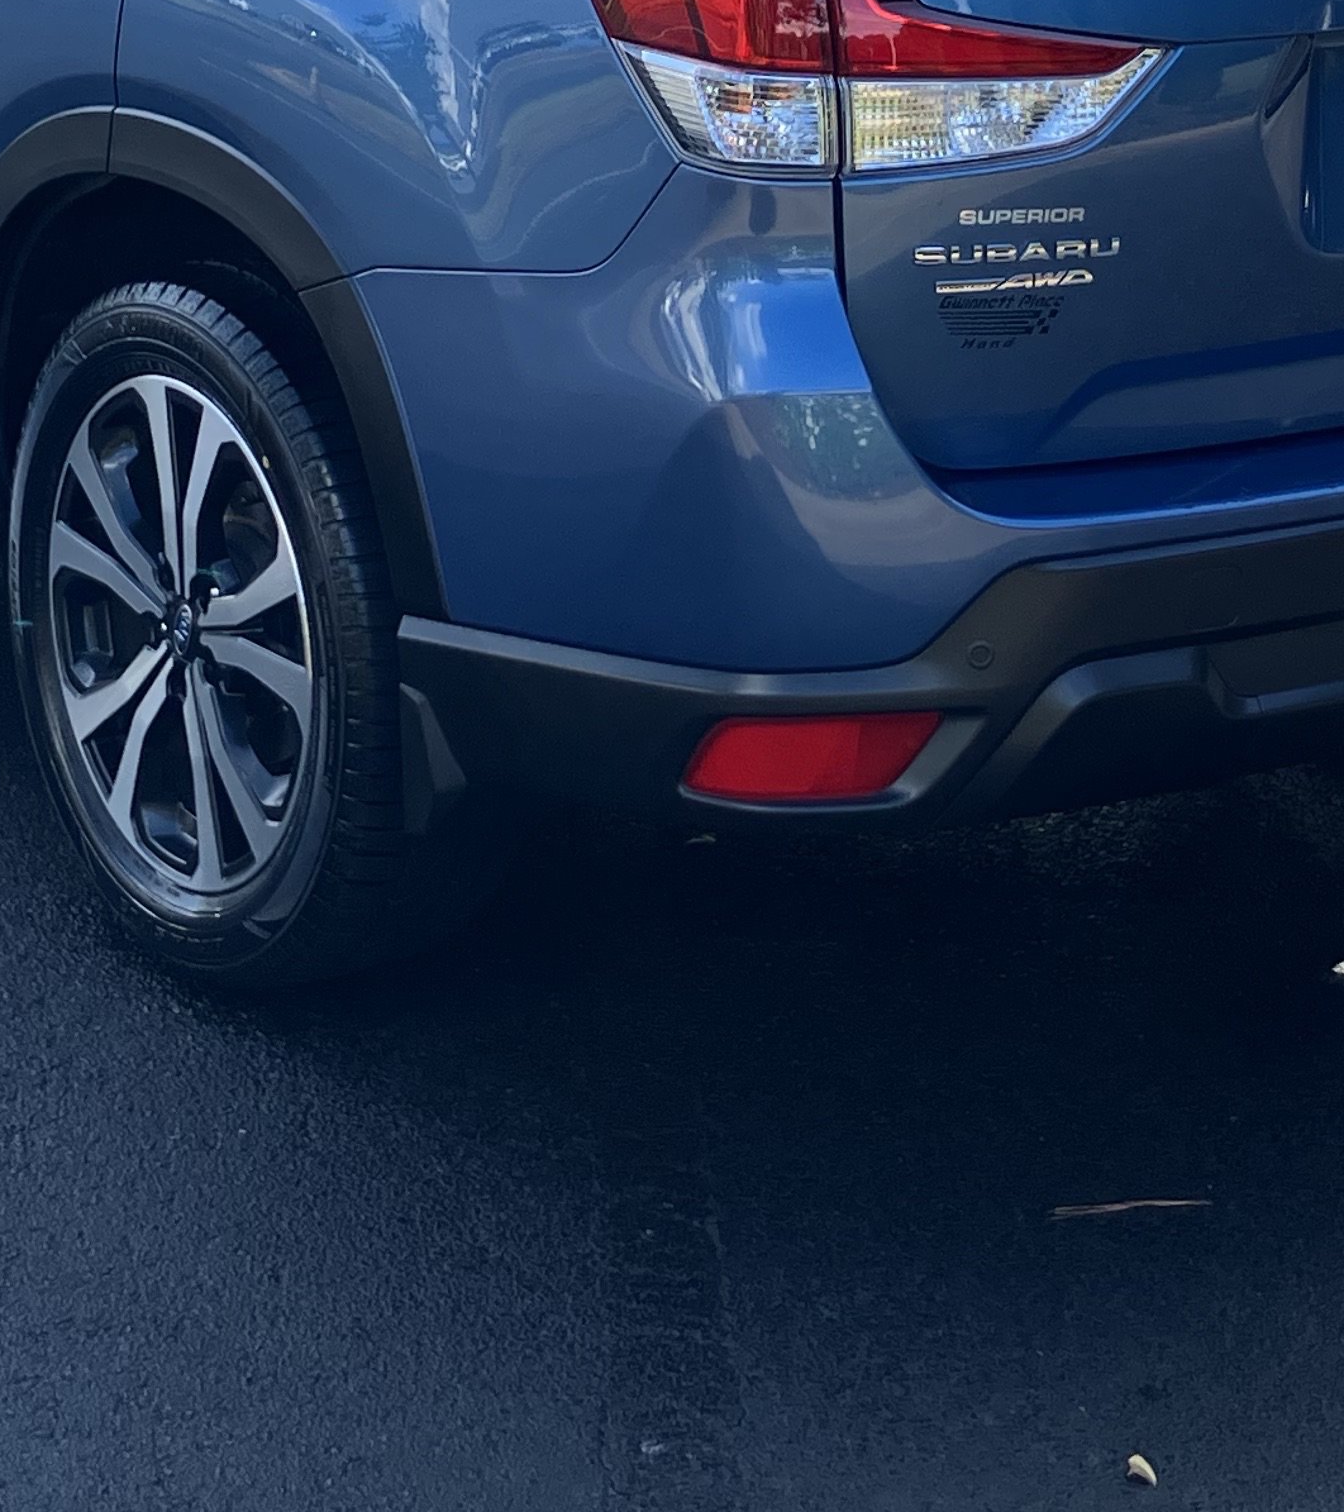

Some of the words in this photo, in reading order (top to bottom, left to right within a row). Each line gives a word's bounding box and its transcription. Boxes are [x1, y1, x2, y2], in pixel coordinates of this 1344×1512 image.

[959, 207, 1085, 225] SUPERIOR
[914, 237, 1120, 266] SUBARU
[996, 269, 1094, 289] AWD
[939, 294, 1015, 309] Gwinnett
